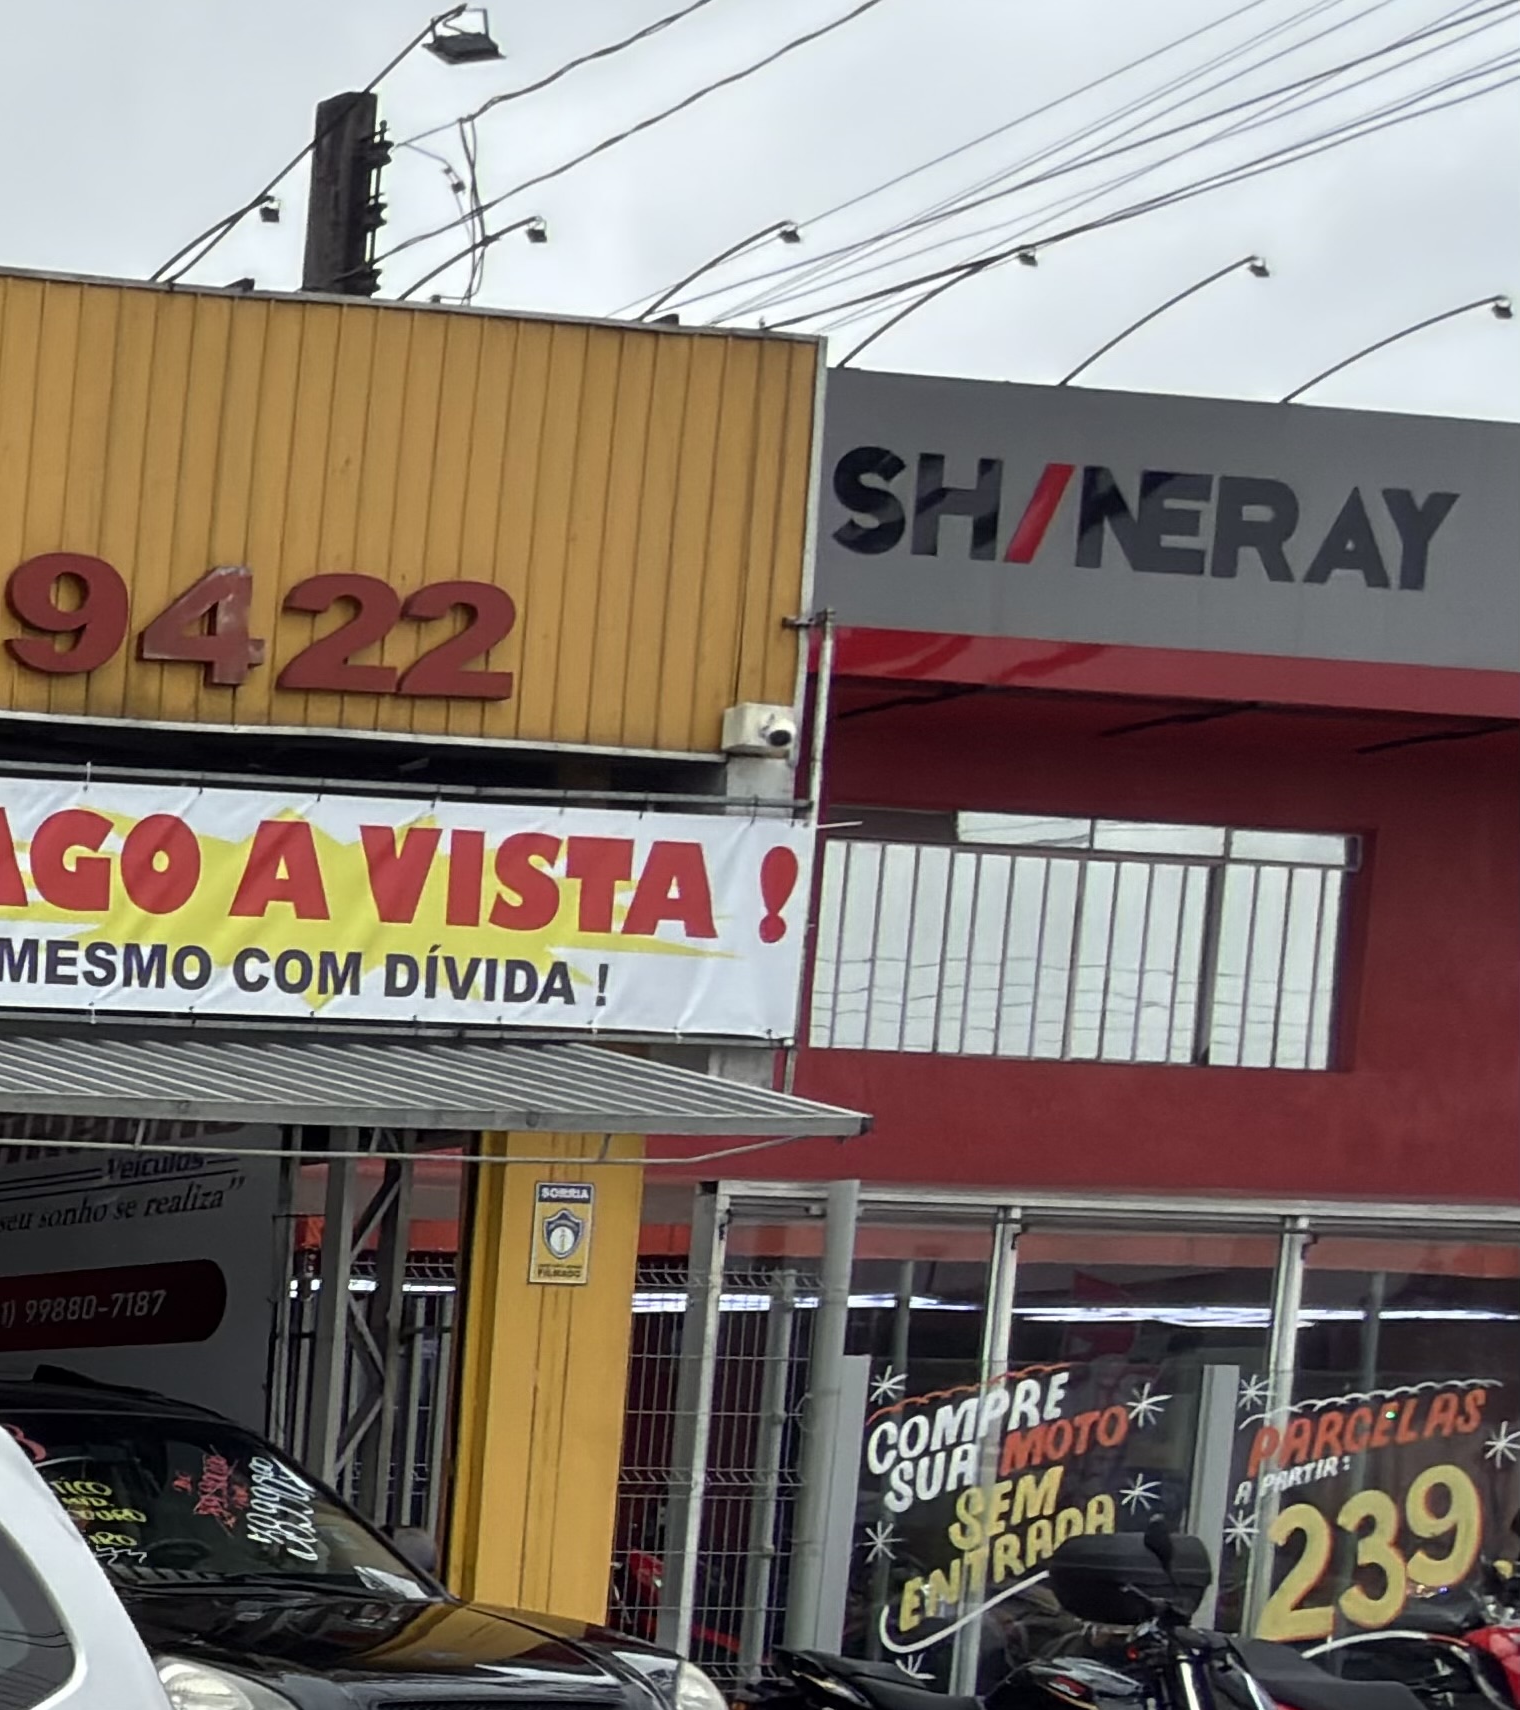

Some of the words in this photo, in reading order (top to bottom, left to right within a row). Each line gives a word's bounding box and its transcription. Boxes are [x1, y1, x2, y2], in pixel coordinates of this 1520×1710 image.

[229, 825, 330, 922] A
[360, 825, 717, 940] VISTA
[759, 845, 799, 944] !
[232, 947, 361, 997] COM
[384, 944, 574, 1007] DÍVIDA
[107, 1152, 208, 1180] Veículos
[38, 1196, 107, 1228] sonho
[113, 1201, 138, 1219] se
[24, 1288, 168, 1325] 99880-7187
[867, 1372, 1070, 1475] COMPRE
[884, 1443, 980, 1512] SUA
[1000, 1405, 1129, 1477] MOTO
[1247, 1388, 1487, 1479] PARCELAS
[948, 1465, 1065, 1552] SEM
[1234, 1480, 1252, 1506] A
[1253, 1464, 1483, 1643] 239
